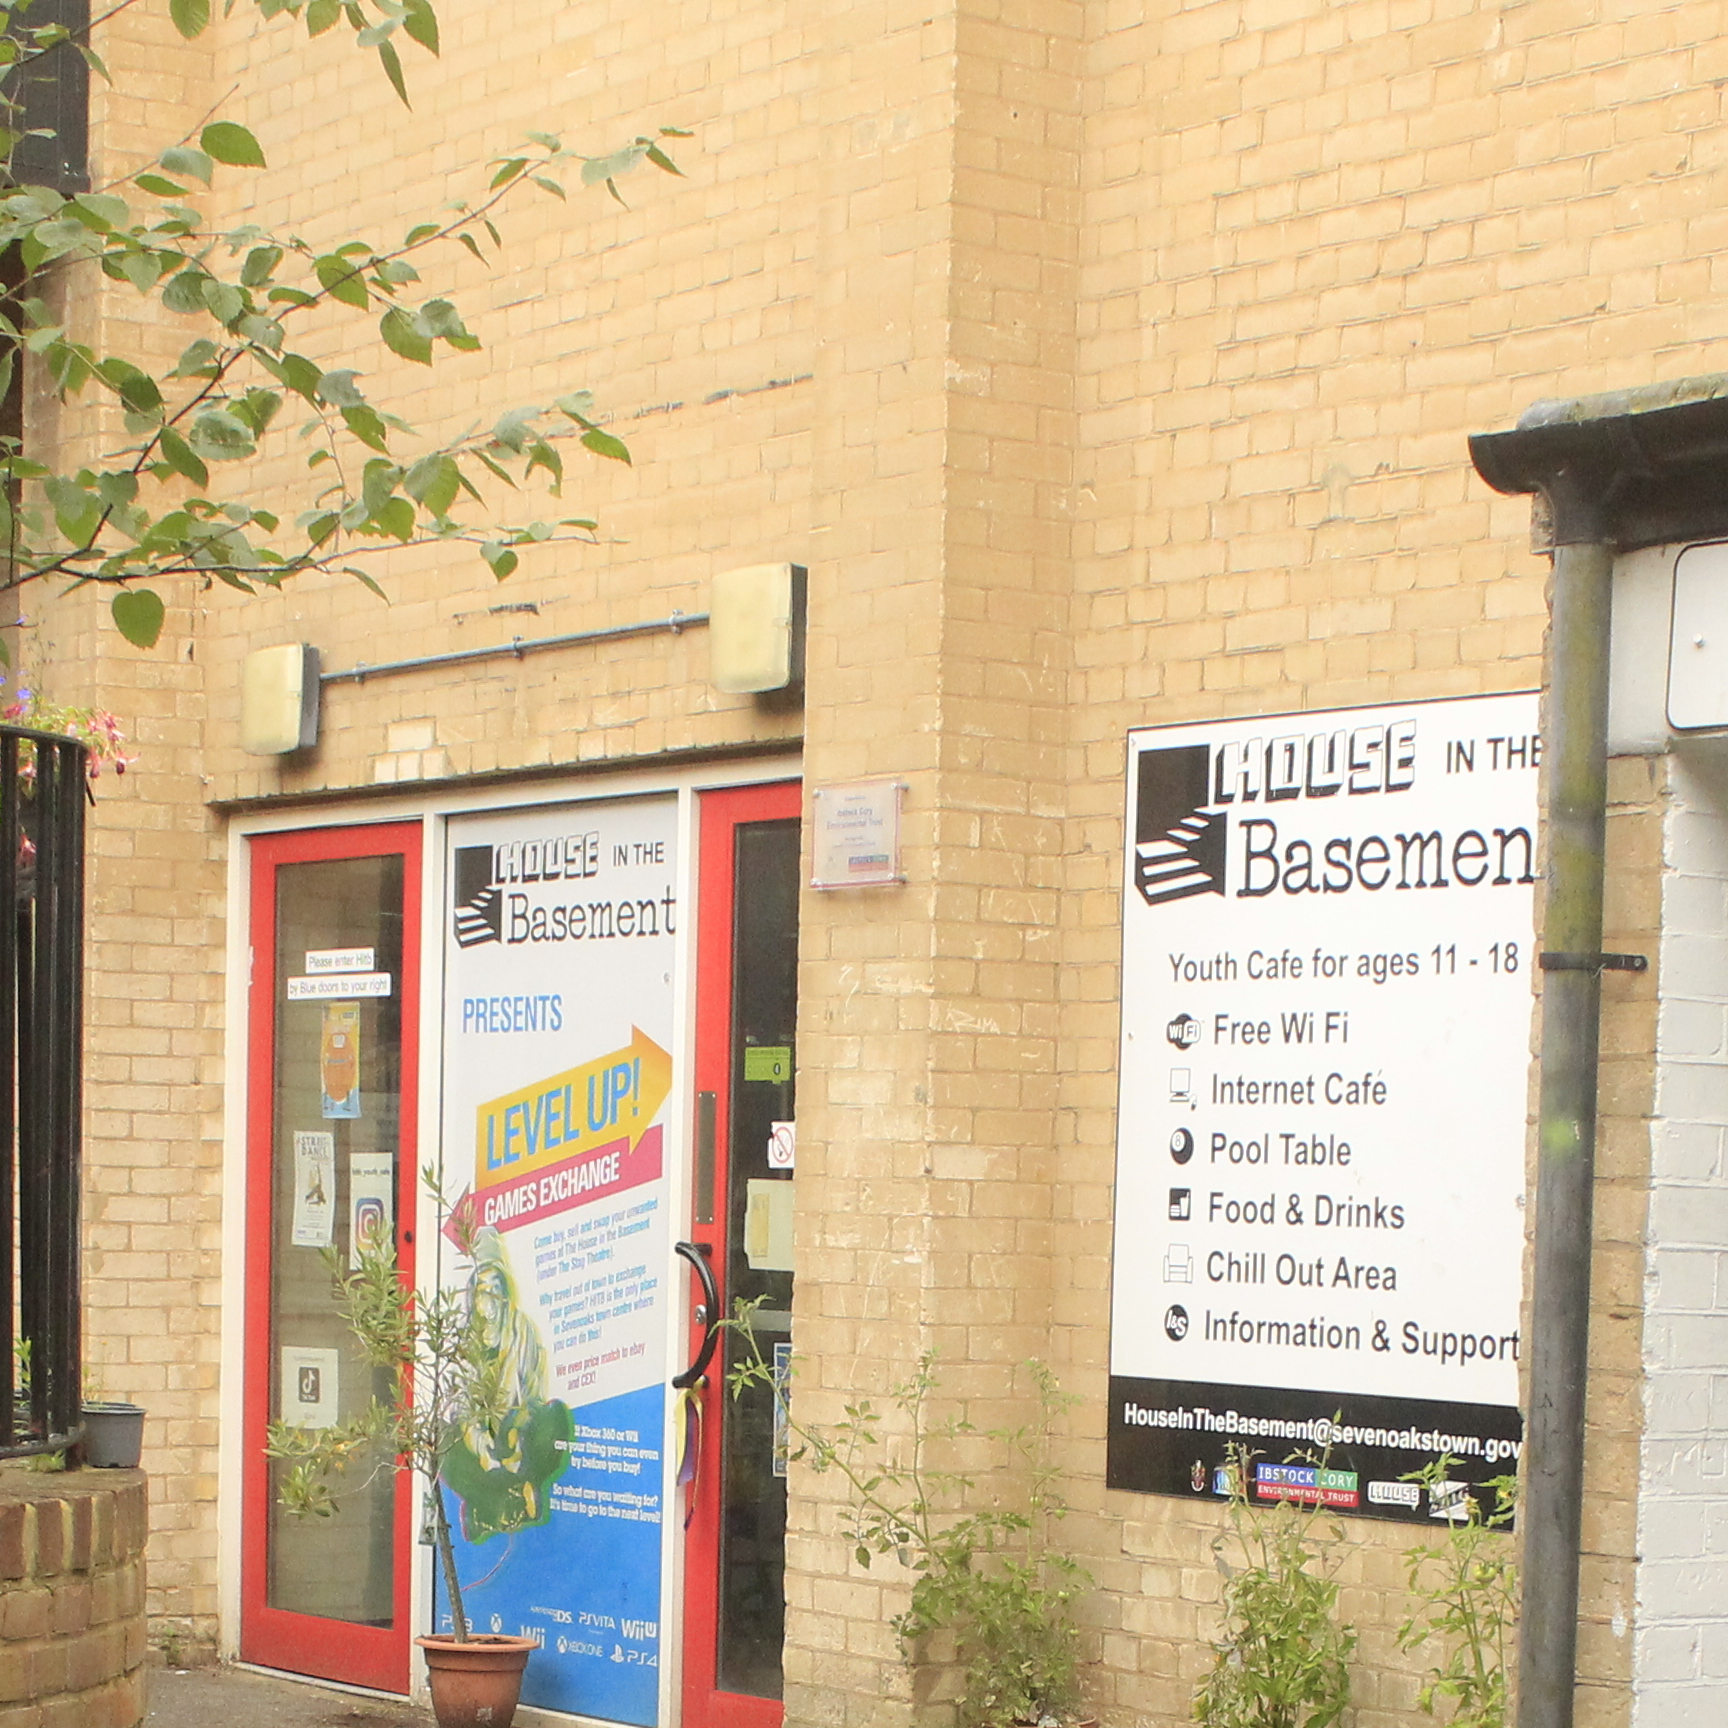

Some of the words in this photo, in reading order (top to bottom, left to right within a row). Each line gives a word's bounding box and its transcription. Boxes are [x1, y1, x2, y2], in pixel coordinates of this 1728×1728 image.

[1213, 718, 1417, 804] HOUSE
[1446, 738, 1475, 774] IN
[1487, 735, 1541, 770] THE
[495, 830, 600, 884] HOUSE
[613, 844, 628, 867] IN
[633, 841, 664, 865] THE
[1237, 817, 1536, 898] Basemen
[507, 884, 676, 945] Basement
[309, 956, 332, 968] Please
[335, 956, 354, 967] enter
[1168, 952, 1238, 982] Youth
[1247, 949, 1304, 980] Cafe
[1312, 948, 1349, 978] for
[1356, 953, 1420, 985] ages
[1431, 943, 1457, 975] 11
[1488, 942, 1519, 975] 18
[290, 984, 298, 996] by
[300, 982, 316, 994] Blue
[318, 982, 339, 993] doors
[341, 982, 349, 992] to
[351, 981, 368, 993] your
[369, 979, 387, 994] right
[463, 993, 563, 1034] PRESENTS
[1214, 1013, 1272, 1046] Free
[1280, 1011, 1314, 1044] Wi
[1324, 1011, 1349, 1044] Fi
[1212, 1073, 1315, 1105] Internet
[1324, 1069, 1387, 1105] Café
[487, 1083, 580, 1171] LEVEL
[587, 1057, 641, 1132] UP!
[1210, 1132, 1269, 1165] Pool
[1279, 1132, 1351, 1166] Table
[484, 1181, 537, 1225] GAMES
[540, 1151, 620, 1207] EXCHANGE
[1208, 1191, 1276, 1225] Food
[1285, 1193, 1304, 1226] &
[1314, 1194, 1405, 1230] Drinks
[1206, 1250, 1266, 1284] Chill
[1276, 1253, 1325, 1288] Out
[1331, 1256, 1398, 1292] Area
[1204, 1309, 1361, 1351] Information
[1371, 1319, 1391, 1353] &
[1401, 1320, 1521, 1367] Support
[556, 1364, 566, 1377] We
[568, 1360, 583, 1373] even
[583, 1356, 599, 1371] price
[600, 1348, 620, 1365] match
[622, 1346, 628, 1358] to
[568, 1376, 580, 1390] and
[1328, 1492, 1355, 1503] TRUST
[442, 1614, 473, 1632] P3
[627, 1650, 658, 1667] PS4
